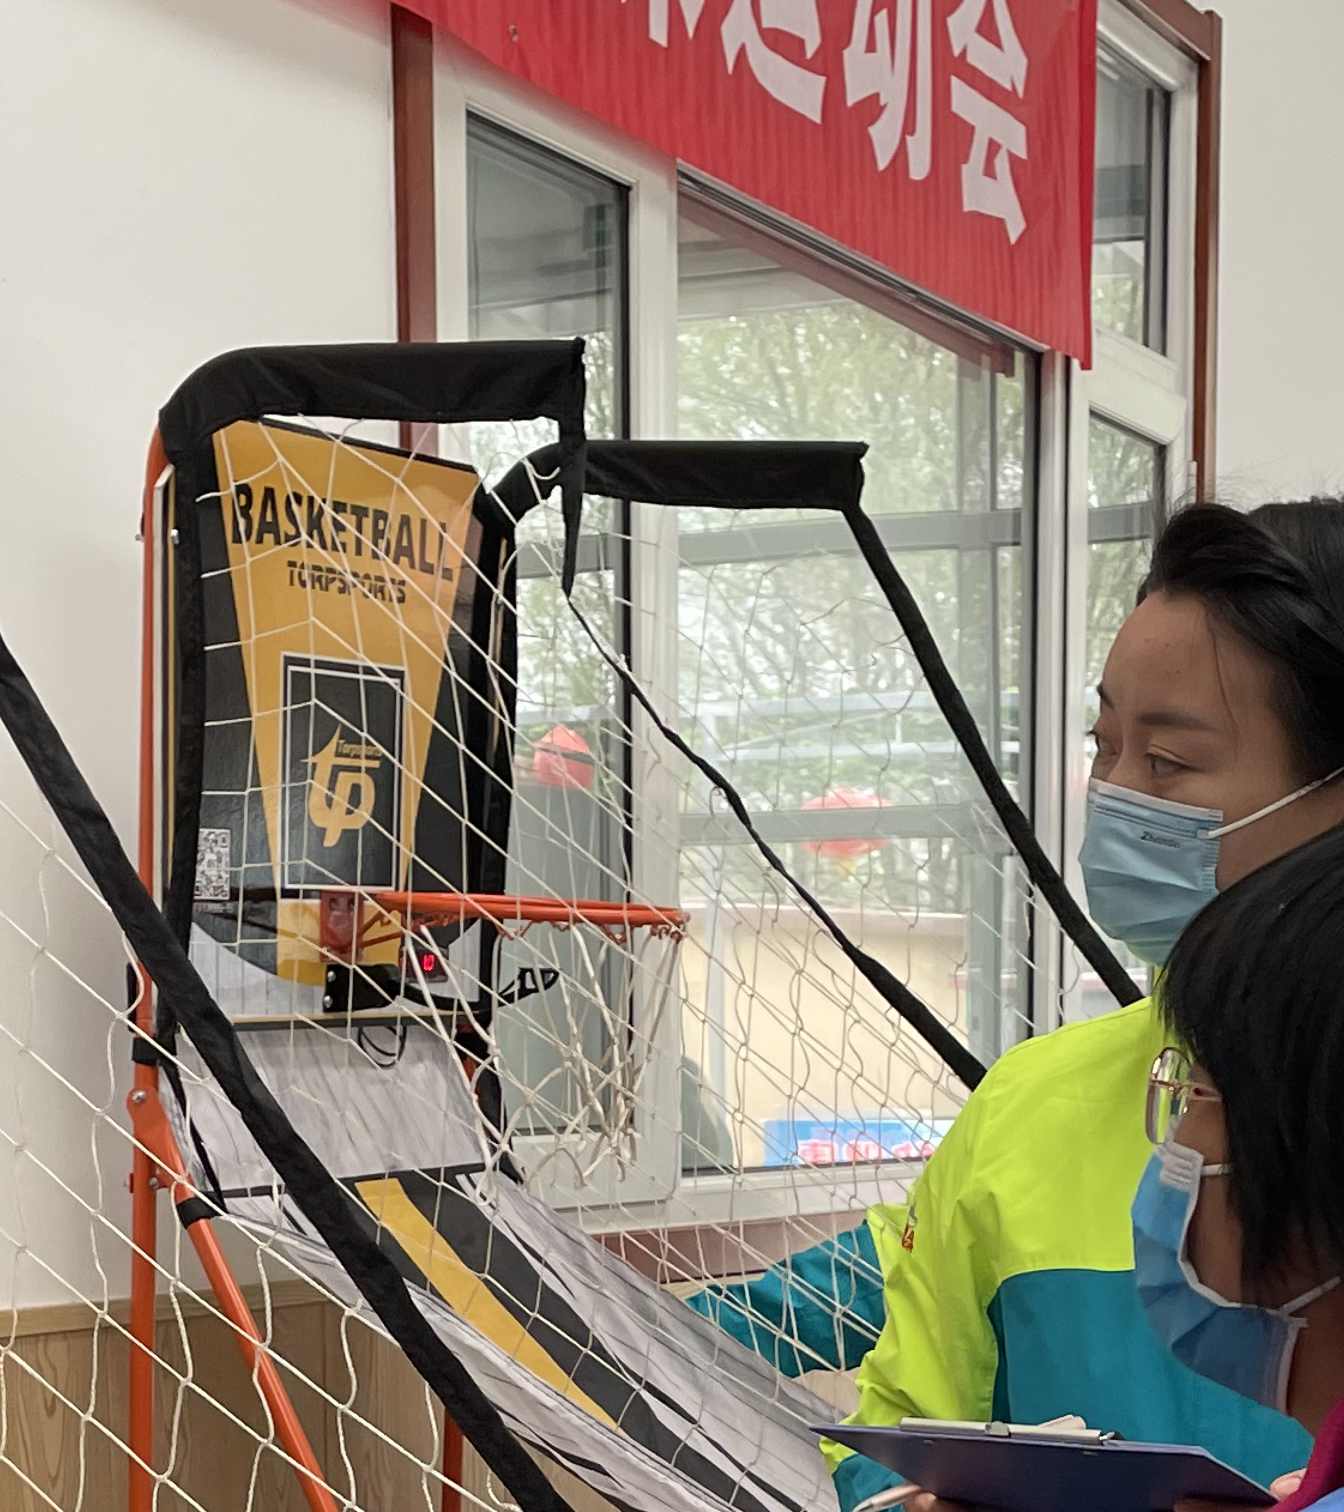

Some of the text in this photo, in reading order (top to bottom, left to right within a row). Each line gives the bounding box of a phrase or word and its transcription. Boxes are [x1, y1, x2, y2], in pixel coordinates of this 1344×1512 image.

[648, 0, 1028, 246] 运动会
[232, 479, 454, 582] BASKETBALL
